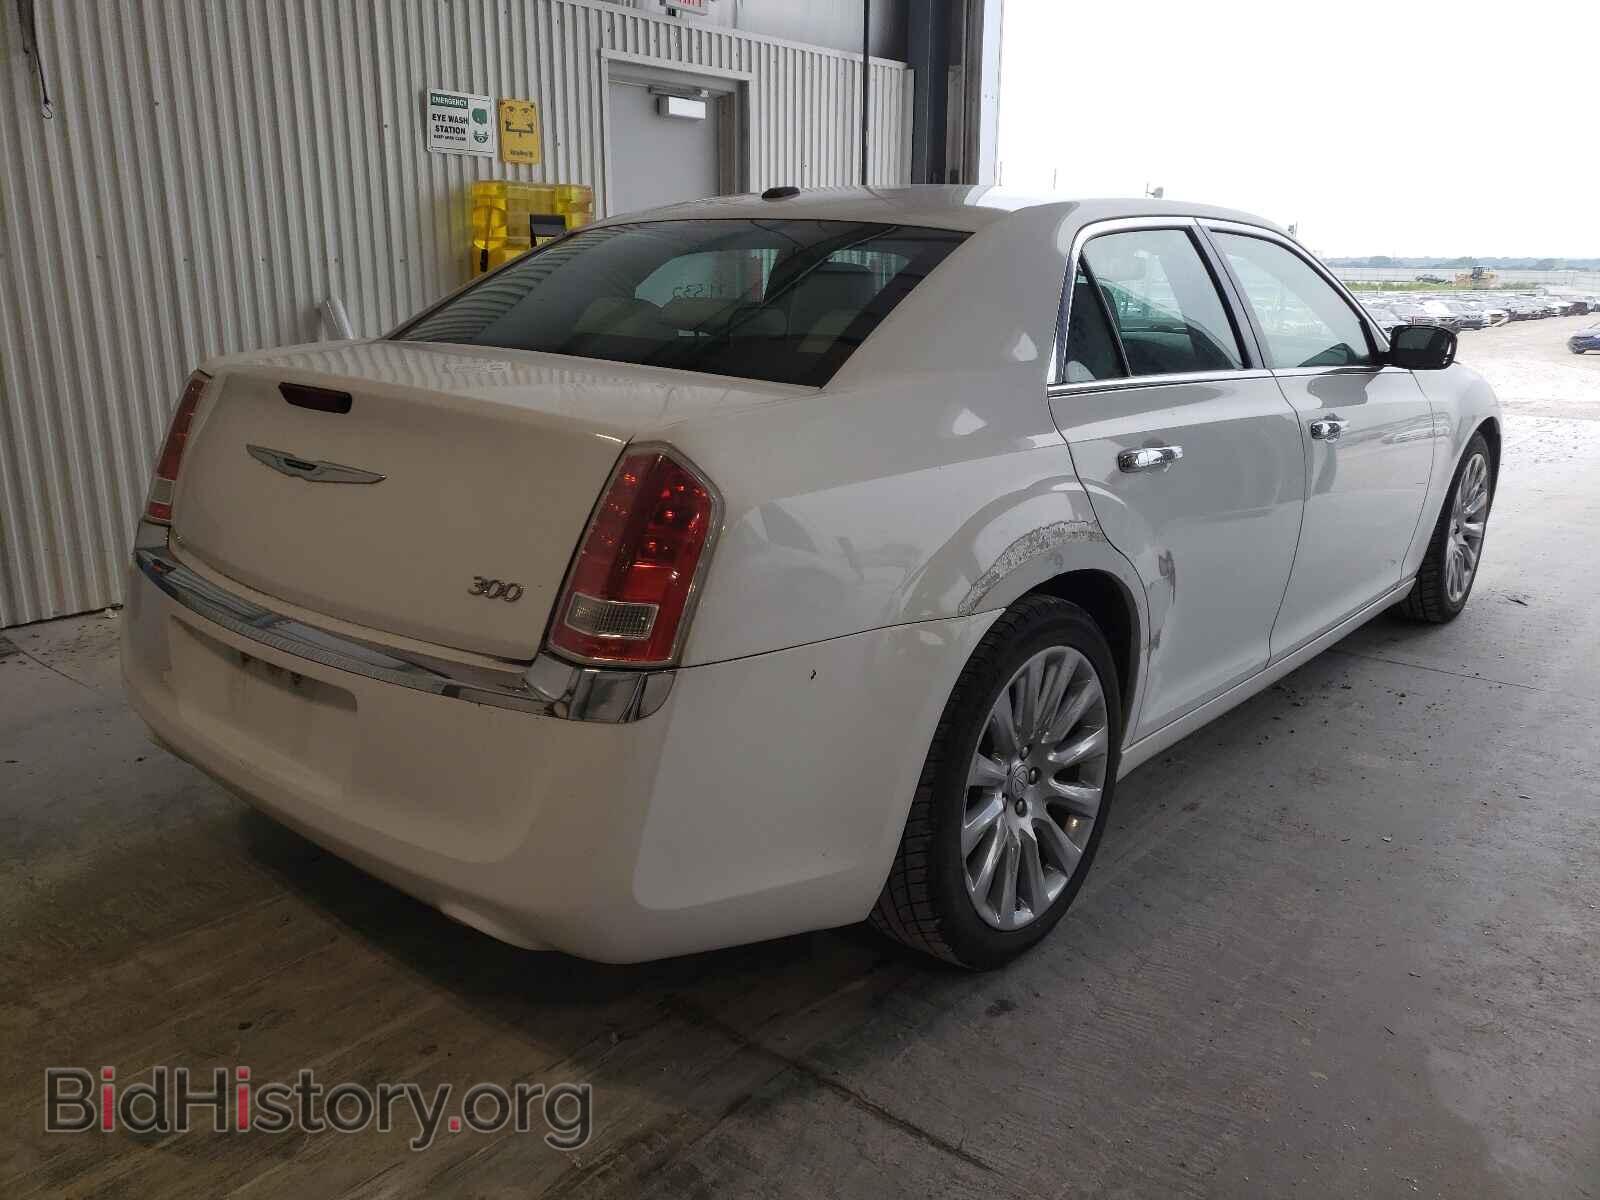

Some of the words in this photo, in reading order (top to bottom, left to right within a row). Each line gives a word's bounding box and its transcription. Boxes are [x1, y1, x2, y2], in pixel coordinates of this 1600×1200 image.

[432, 96, 467, 106] EMERGENCY
[432, 113, 447, 122] EYE
[448, 115, 468, 125] WASH
[435, 124, 466, 135] STATION
[467, 576, 524, 603] 300
